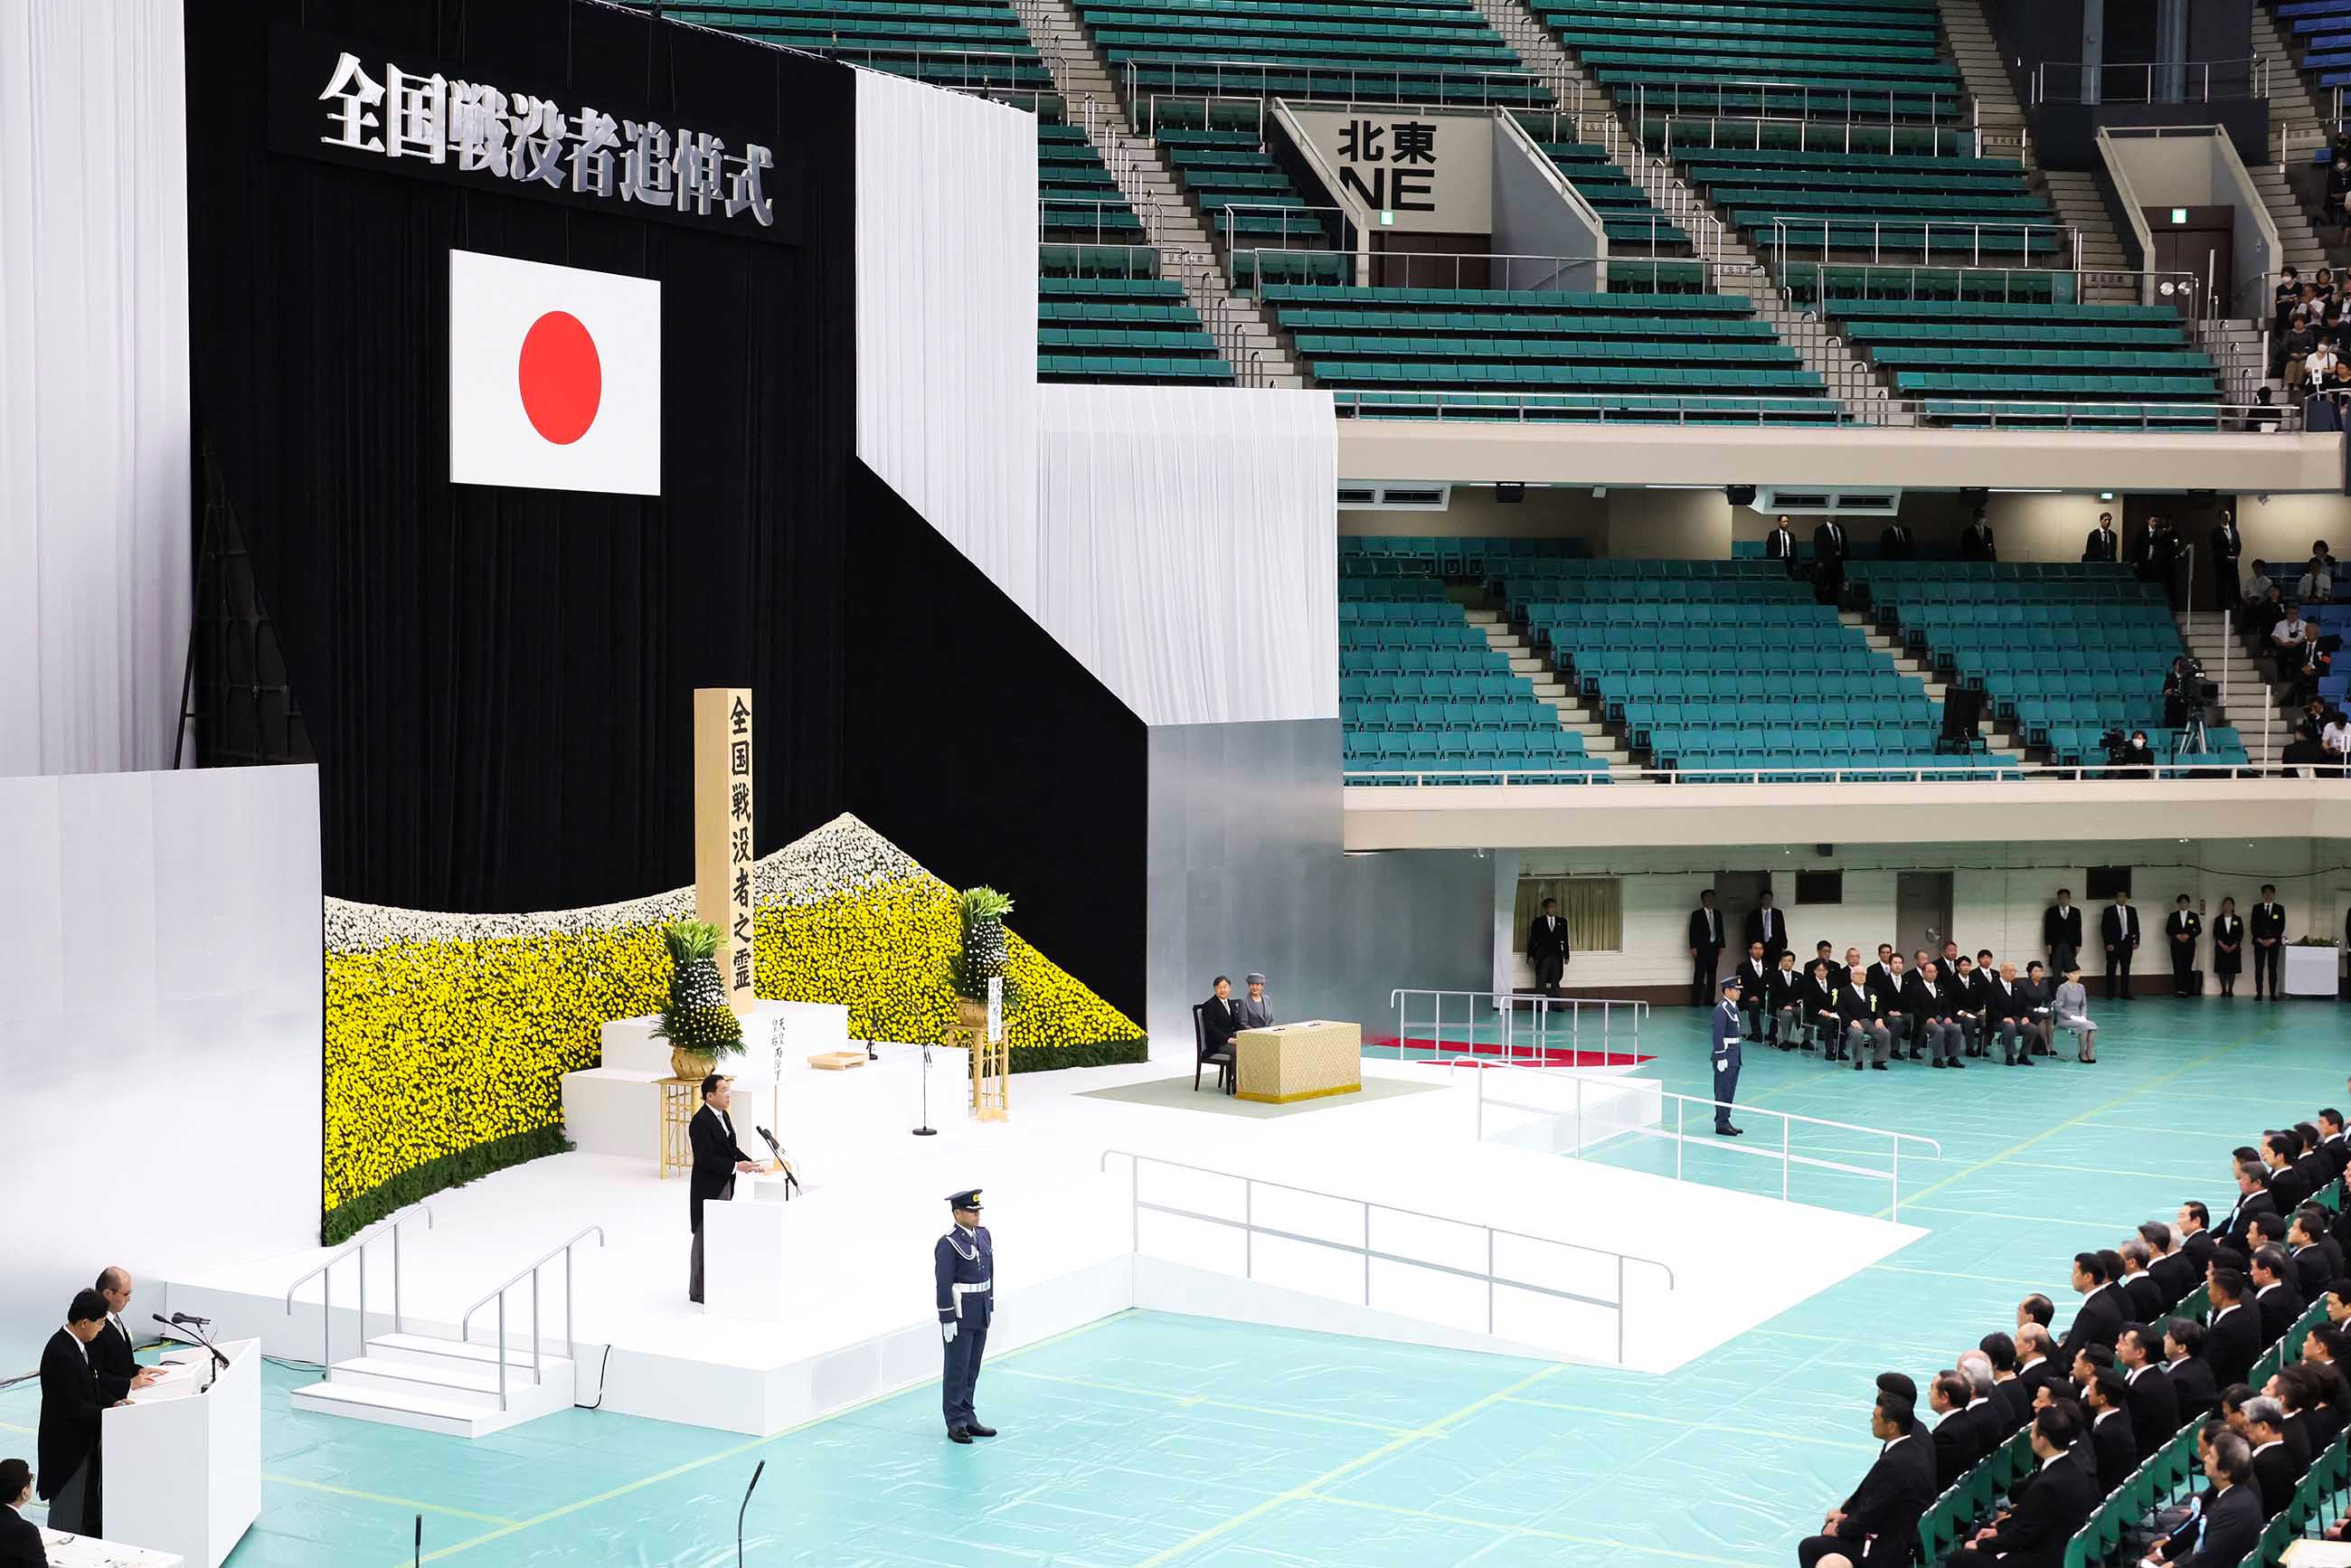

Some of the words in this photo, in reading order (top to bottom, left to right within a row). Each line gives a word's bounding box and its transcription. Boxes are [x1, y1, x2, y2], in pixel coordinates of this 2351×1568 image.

[318, 52, 773, 226] 全国戦没者追悼式
[1337, 119, 1437, 165] 北東
[1338, 166, 1435, 212] NE
[730, 695, 752, 992] 全国戦没者之霊
